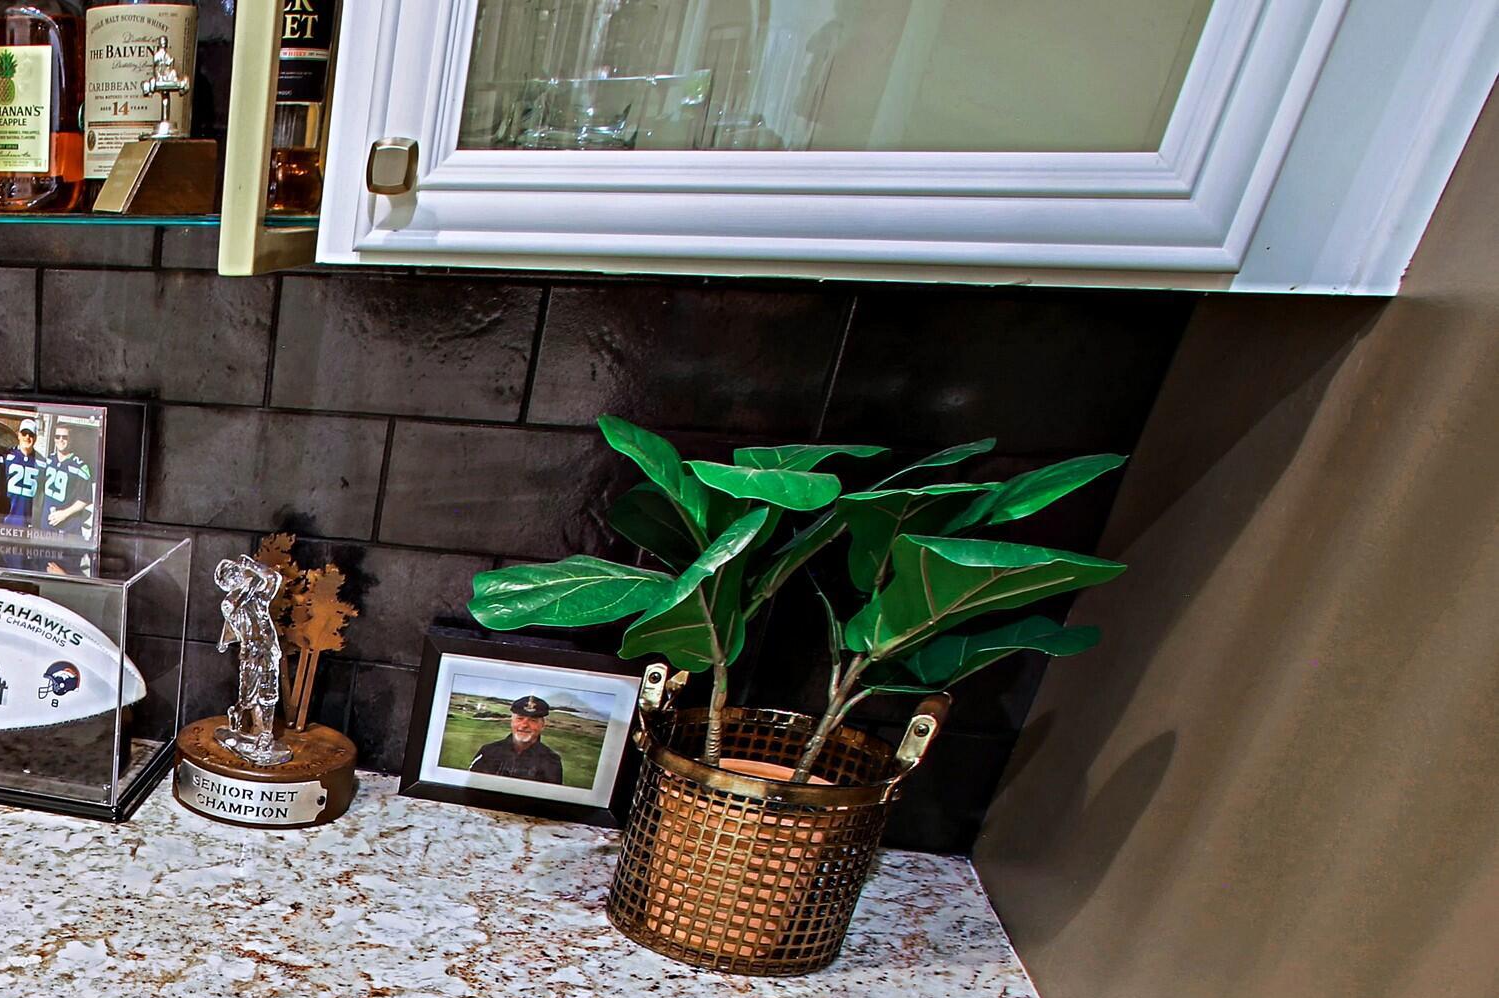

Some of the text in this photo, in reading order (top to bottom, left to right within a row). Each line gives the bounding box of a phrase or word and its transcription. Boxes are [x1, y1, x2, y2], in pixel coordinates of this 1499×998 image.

[104, 15, 120, 25] MALT
[120, 14, 146, 24] SCOTCH
[89, 44, 160, 60] THE BALVEN
[88, 81, 138, 92] CARIBBEAN
[112, 101, 130, 116] 14
[7, 463, 39, 498] 25
[45, 466, 68, 502] 29
[6, 616, 66, 648] CHAMPIONS
[51, 698, 59, 707] 8
[192, 774, 298, 803] SENIOR NET
[197, 793, 289, 819] CHAMPION
